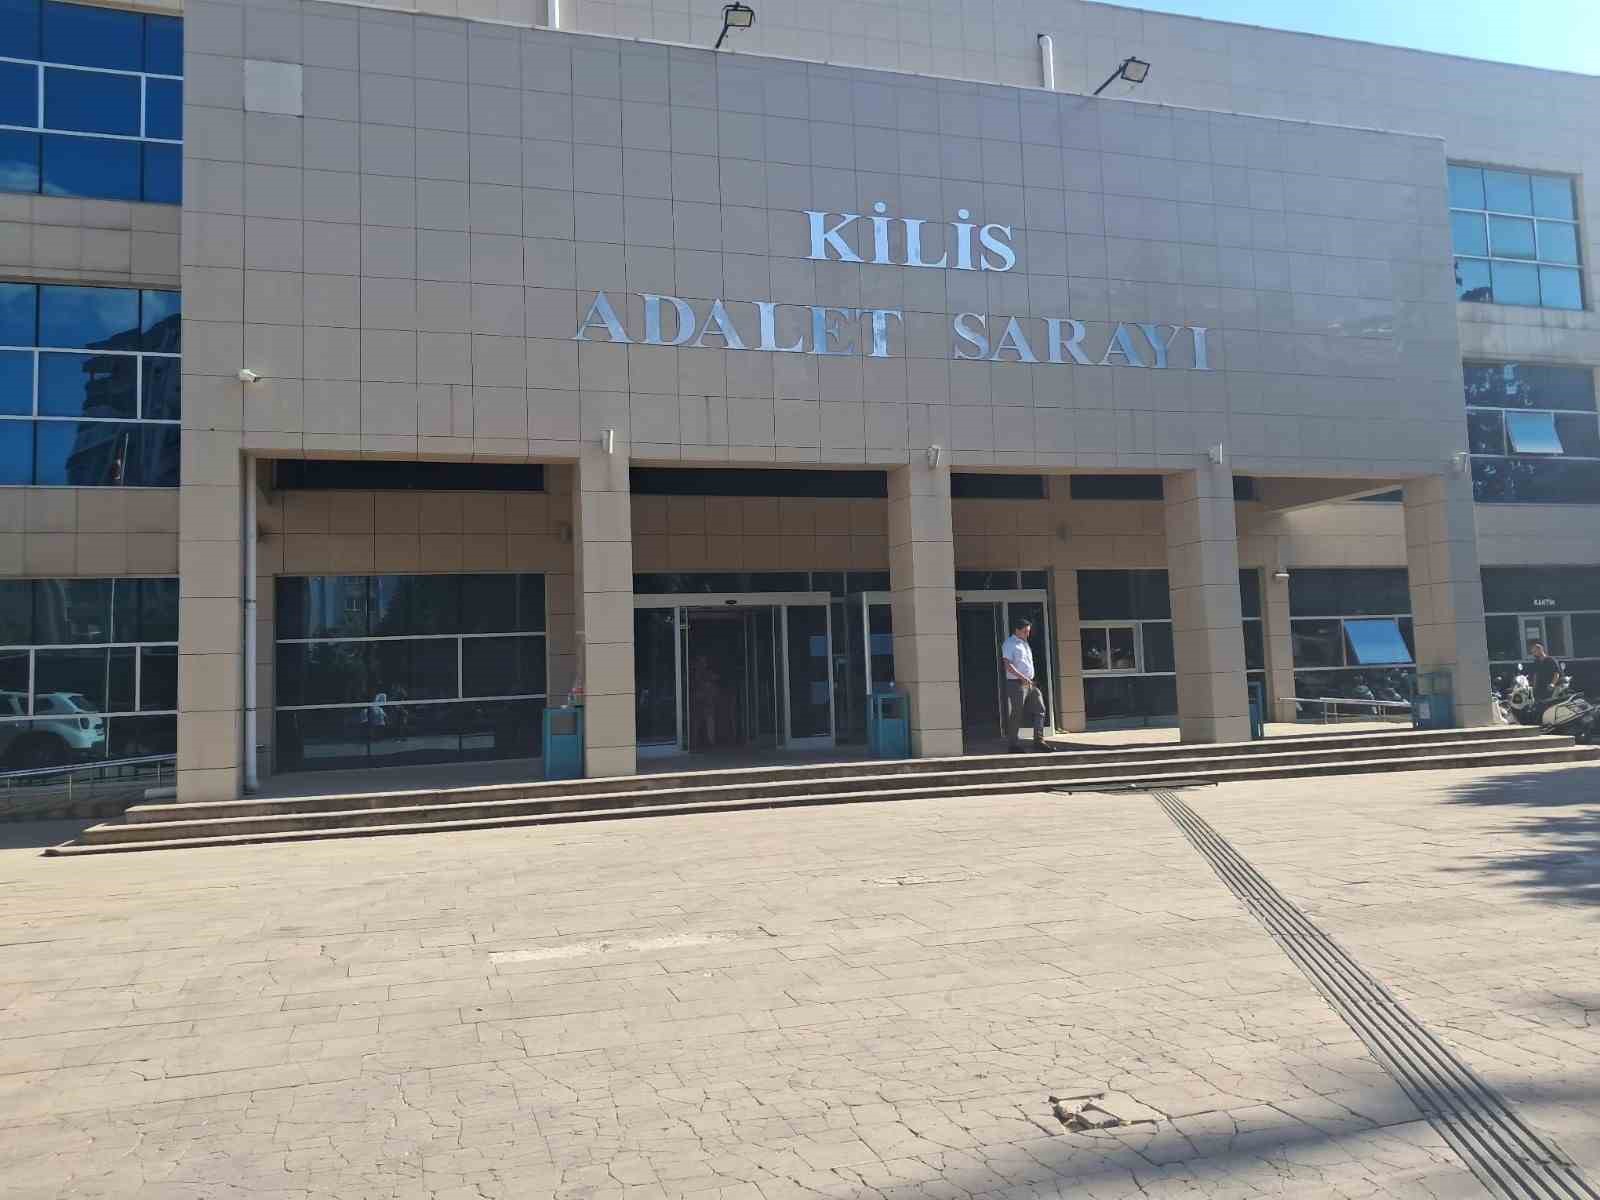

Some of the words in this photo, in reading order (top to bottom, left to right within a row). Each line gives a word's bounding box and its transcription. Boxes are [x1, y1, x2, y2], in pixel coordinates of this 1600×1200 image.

[804, 201, 1016, 272] KİLİS
[573, 290, 903, 358] ADALET
[953, 312, 1210, 371] SARAYI
